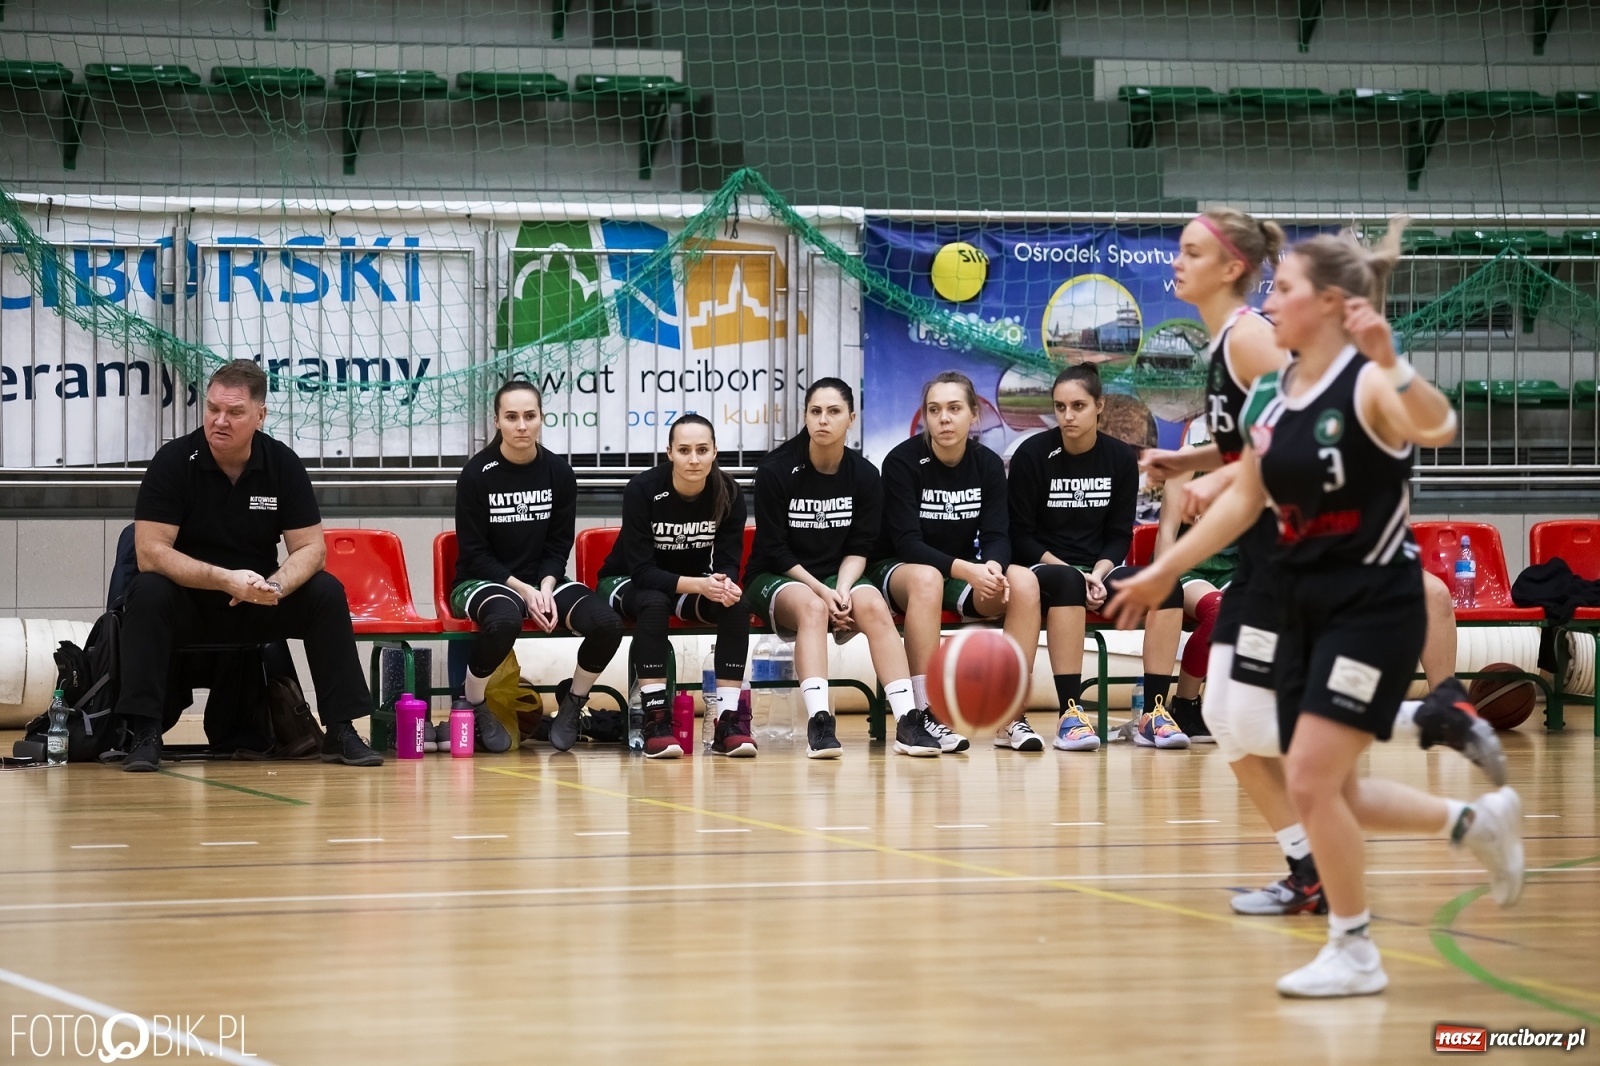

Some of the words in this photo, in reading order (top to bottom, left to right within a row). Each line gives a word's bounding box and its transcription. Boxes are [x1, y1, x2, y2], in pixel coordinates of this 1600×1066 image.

[1014, 242, 1101, 263] Ośrodek
[1107, 244, 1174, 268] Sportu
[641, 359, 805, 393] raciborsk
[1317, 447, 1346, 493] 3
[1050, 477, 1112, 491] KATOWICE
[488, 489, 553, 506] KATOWICE
[922, 488, 981, 504] KATOWICE
[1047, 500, 1088, 508] BASKETBALL
[1088, 499, 1110, 507] TEAM
[789, 497, 853, 512] KATOWICE
[830, 519, 852, 528] TEAM
[460, 723, 468, 748] Tacx
